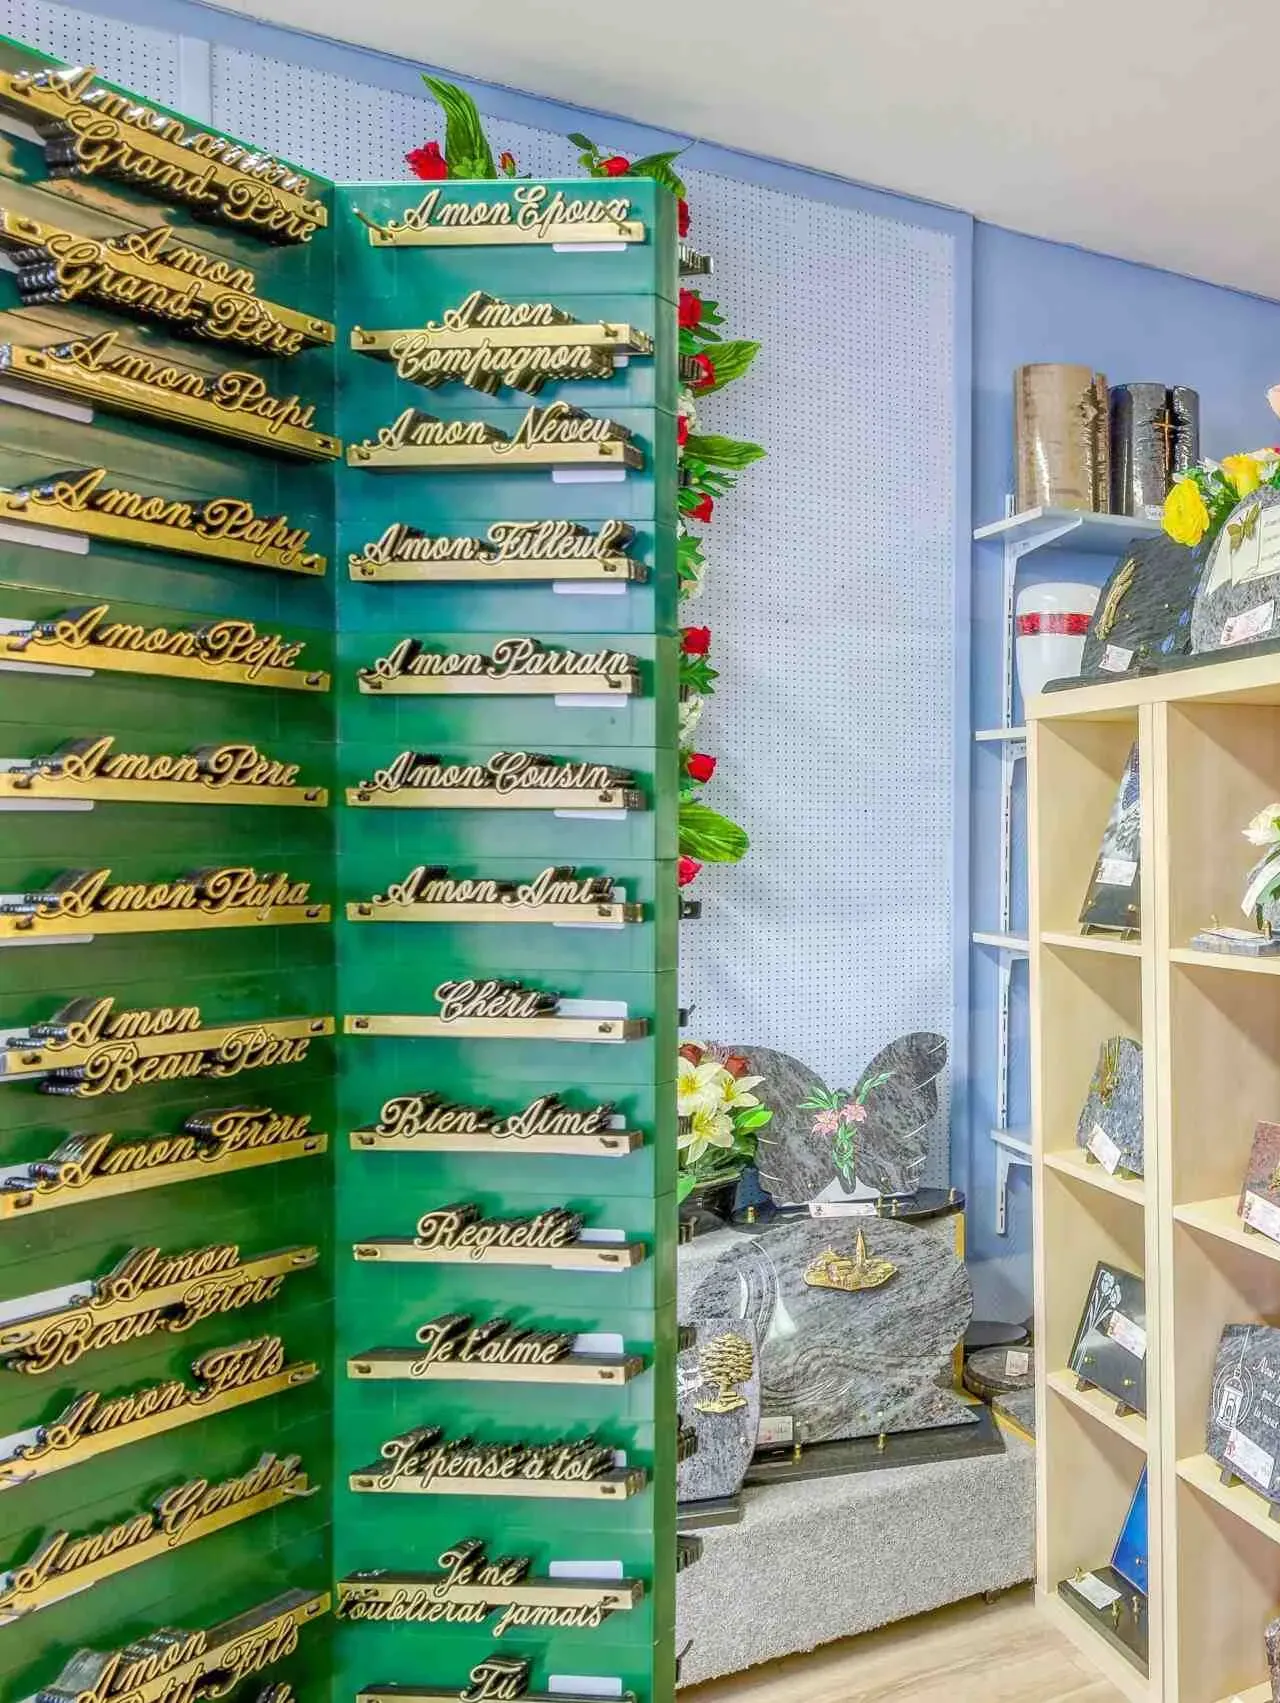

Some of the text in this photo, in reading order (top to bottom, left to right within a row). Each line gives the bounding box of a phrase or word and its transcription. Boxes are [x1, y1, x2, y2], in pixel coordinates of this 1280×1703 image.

[514, 185, 630, 239] Epoux
[390, 334, 593, 389] Compagnon
[491, 401, 612, 454] Neveu
[195, 498, 310, 563] Papy
[479, 520, 616, 566] Filleul
[201, 620, 305, 679] Pépé
[487, 638, 630, 679] Parrain
[202, 745, 301, 789] Père
[487, 751, 610, 794] Cousin
[200, 867, 311, 921] Papa
[501, 867, 594, 908] Ami
[434, 979, 536, 1023] Chéri
[199, 1107, 311, 1163] Frère
[414, 1211, 570, 1261] Regretté
[410, 1324, 453, 1377] Je
[377, 1440, 418, 1490] Je
[421, 1452, 516, 1488] pense
[551, 1450, 595, 1482] toi
[433, 1550, 518, 1597] Je ne
[491, 1602, 602, 1637] jamais
[460, 1664, 518, 1702] Tu
